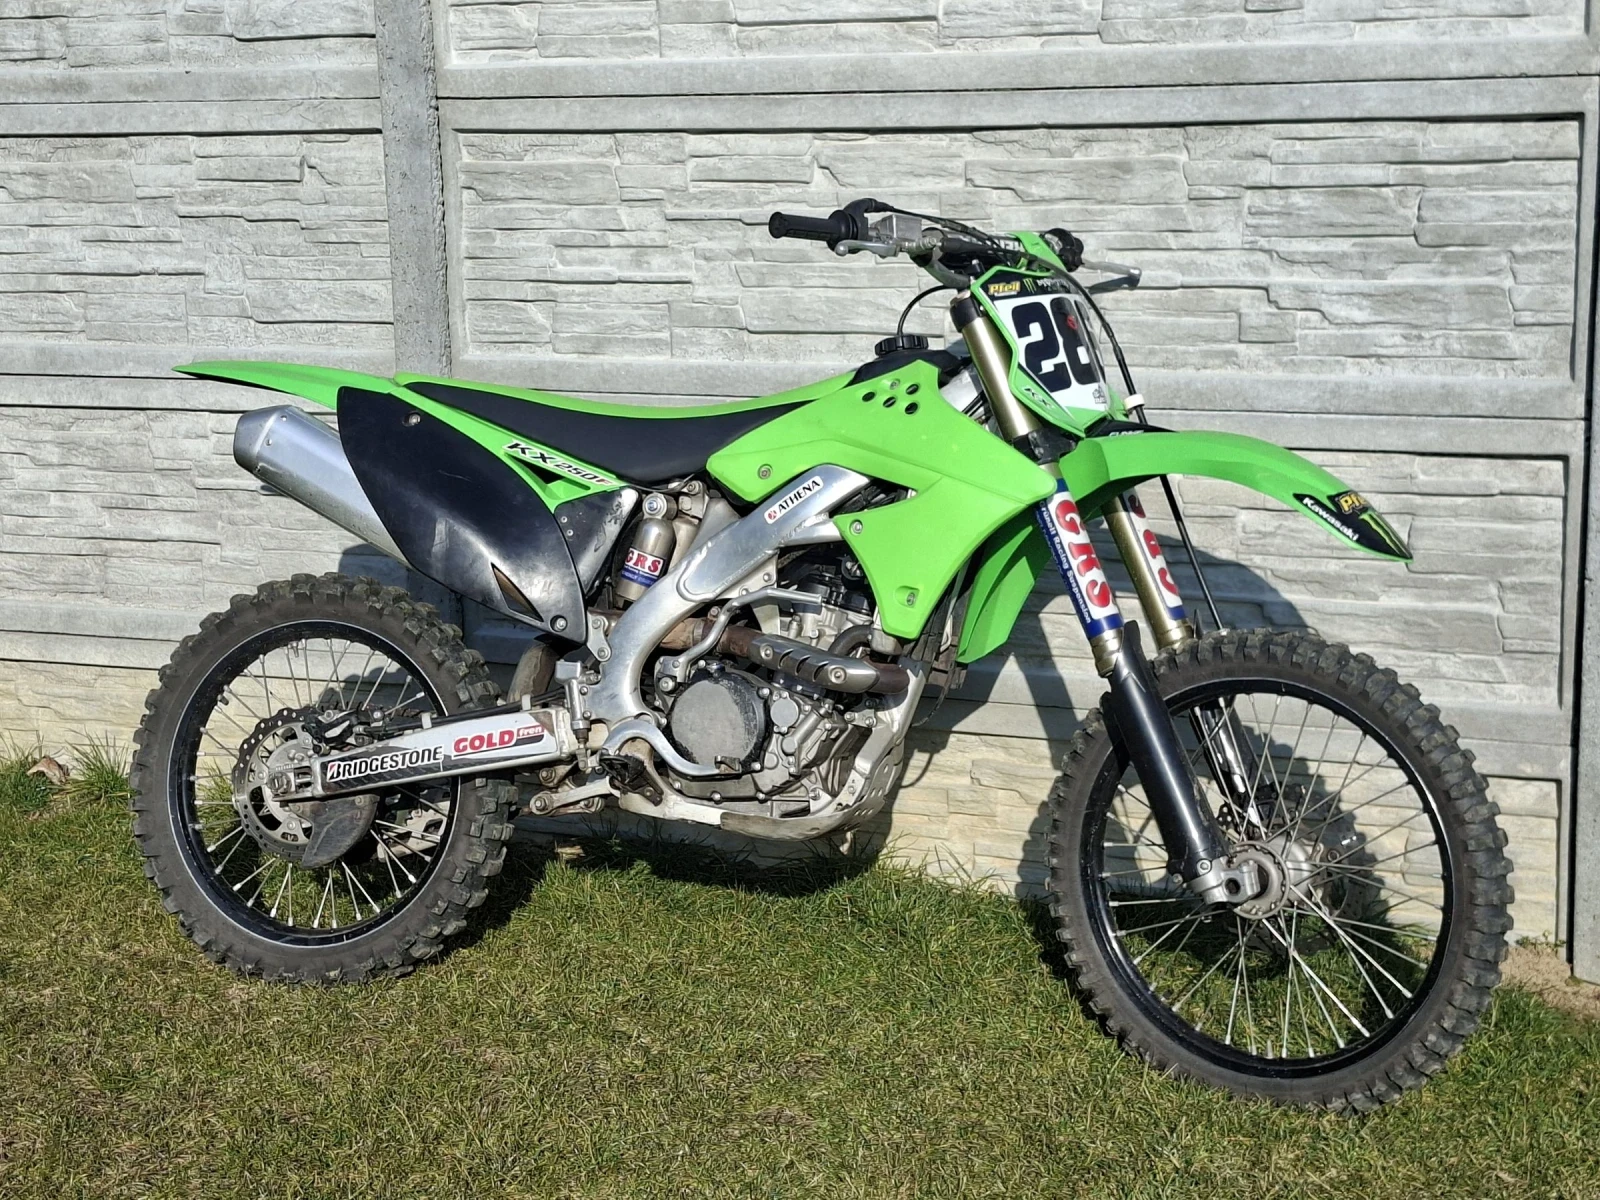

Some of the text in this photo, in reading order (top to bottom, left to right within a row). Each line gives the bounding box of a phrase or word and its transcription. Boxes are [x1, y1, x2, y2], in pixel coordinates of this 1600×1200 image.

[778, 480, 821, 514] ATHENA
[1303, 497, 1360, 541] Kawasaki
[1053, 535, 1070, 570] Racing
[1066, 569, 1092, 624] Suspension
[454, 730, 515, 753] GOLD
[328, 746, 443, 781] BRIDGESTONE
